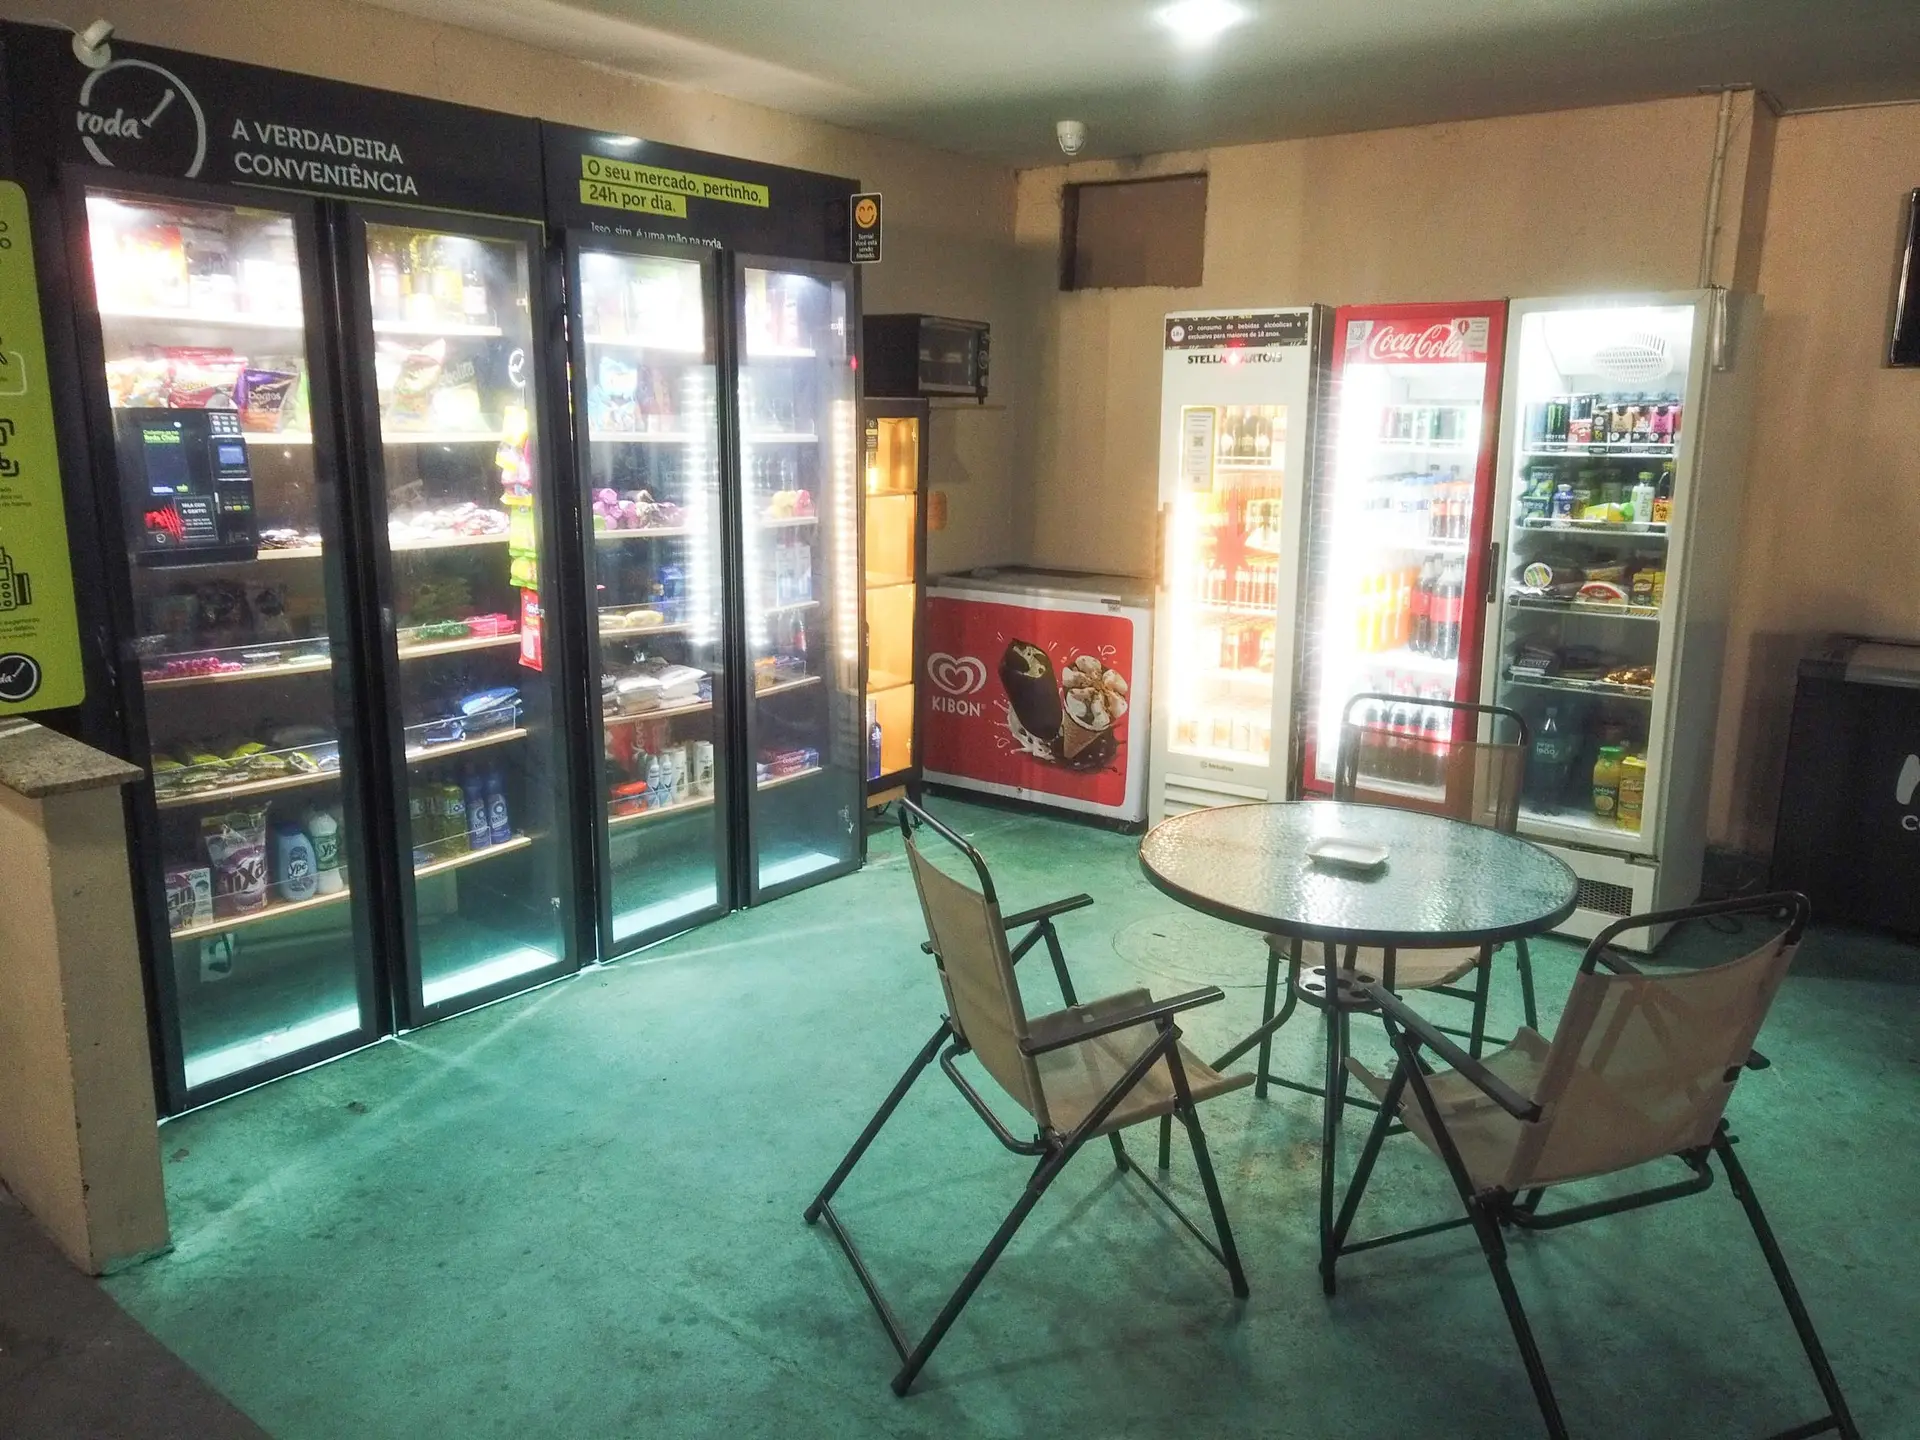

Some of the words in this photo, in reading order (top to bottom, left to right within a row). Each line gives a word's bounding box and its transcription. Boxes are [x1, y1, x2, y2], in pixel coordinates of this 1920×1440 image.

[77, 108, 143, 139] roda
[231, 118, 250, 141] A
[253, 121, 404, 165] VERDADEIRA
[234, 151, 419, 196] CONVENIÊNCIA
[587, 159, 600, 176] O
[604, 166, 630, 181] seu
[634, 170, 700, 194] mercado,
[703, 180, 762, 204] pertinho,
[589, 184, 618, 204] 24h
[621, 191, 647, 209] por
[650, 196, 676, 212] dia.
[1213, 332, 1226, 340] para
[1187, 354, 1227, 364] STELLA
[248, 391, 281, 401] Doritos
[932, 695, 980, 717] KIBON
[1902, 815, 1920, 831] C
